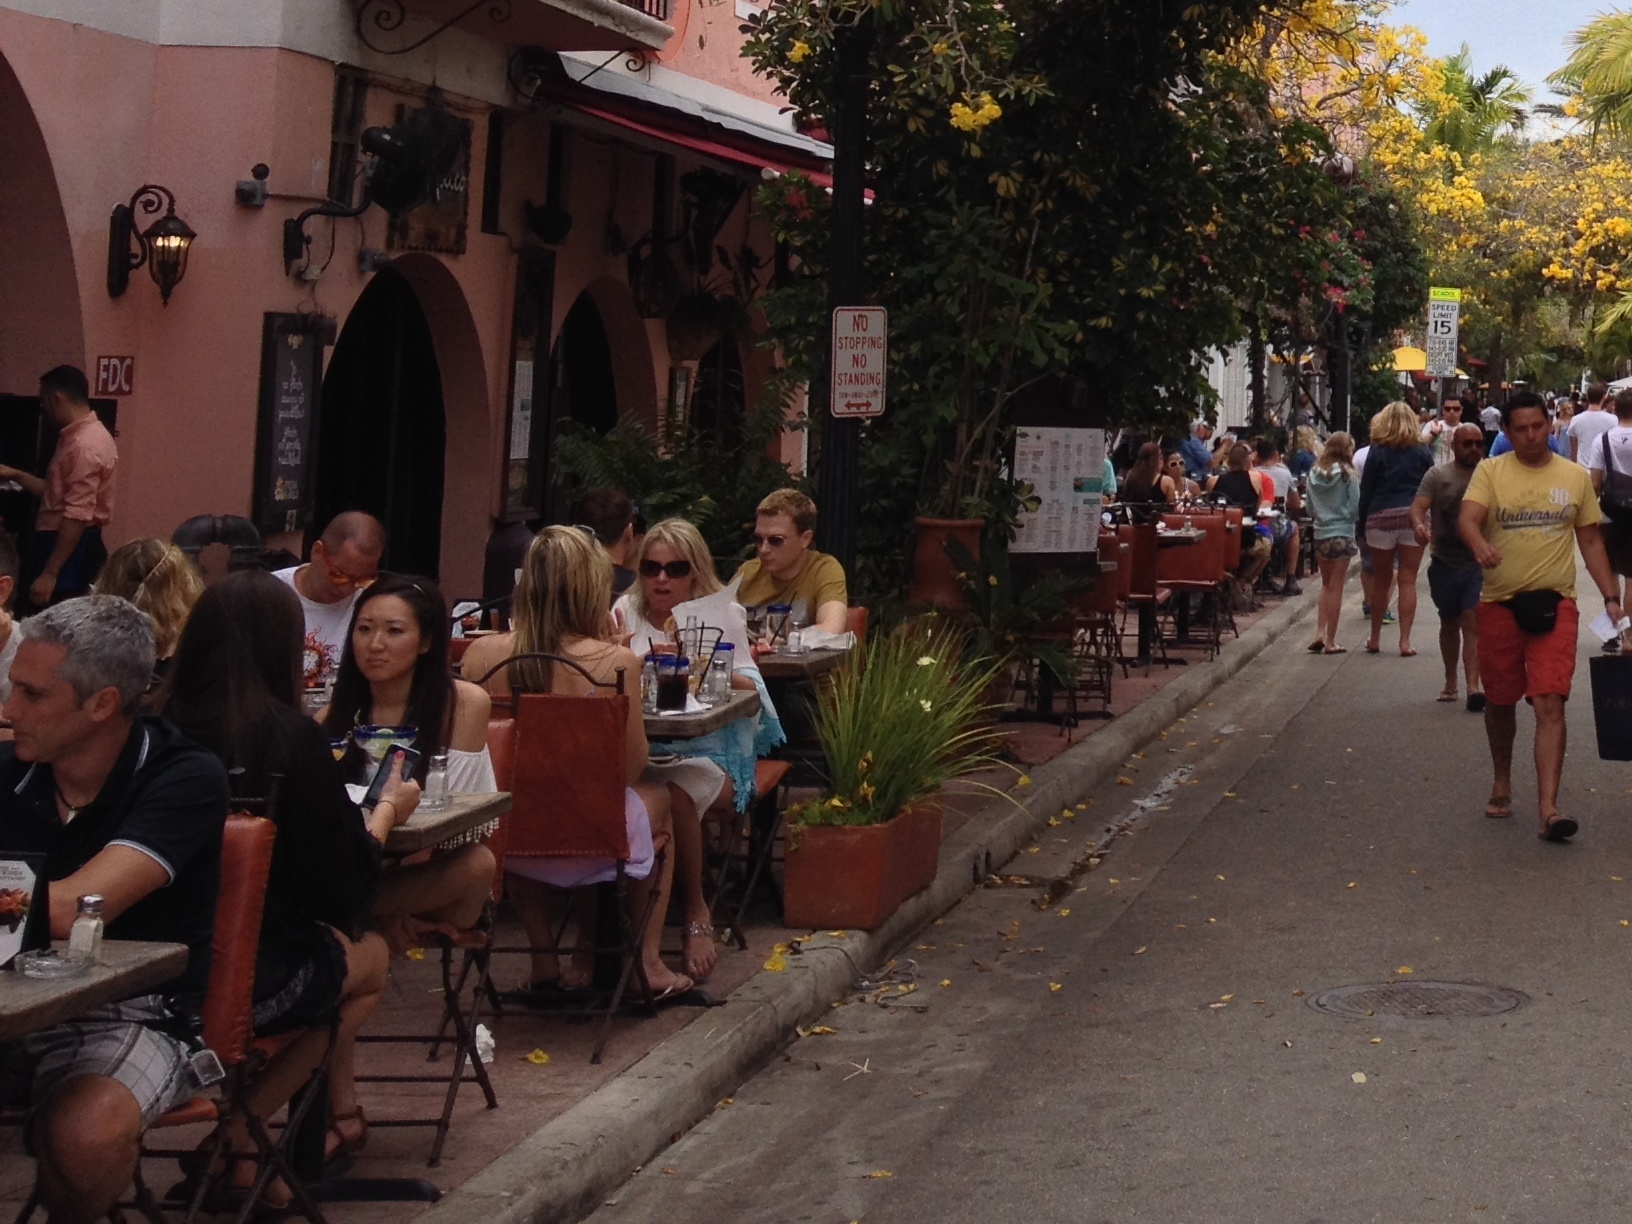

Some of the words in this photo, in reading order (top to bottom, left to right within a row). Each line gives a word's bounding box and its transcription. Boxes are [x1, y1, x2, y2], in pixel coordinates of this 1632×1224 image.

[1431, 303, 1457, 311] SPEED
[852, 314, 868, 332] NO
[1432, 312, 1453, 320] LIMIT
[1433, 319, 1452, 335] 15
[837, 336, 883, 350] STOPPING
[852, 354, 867, 369] NO
[98, 357, 132, 392] FDC
[837, 372, 881, 387] STANDING
[1494, 503, 1569, 523] Universal
